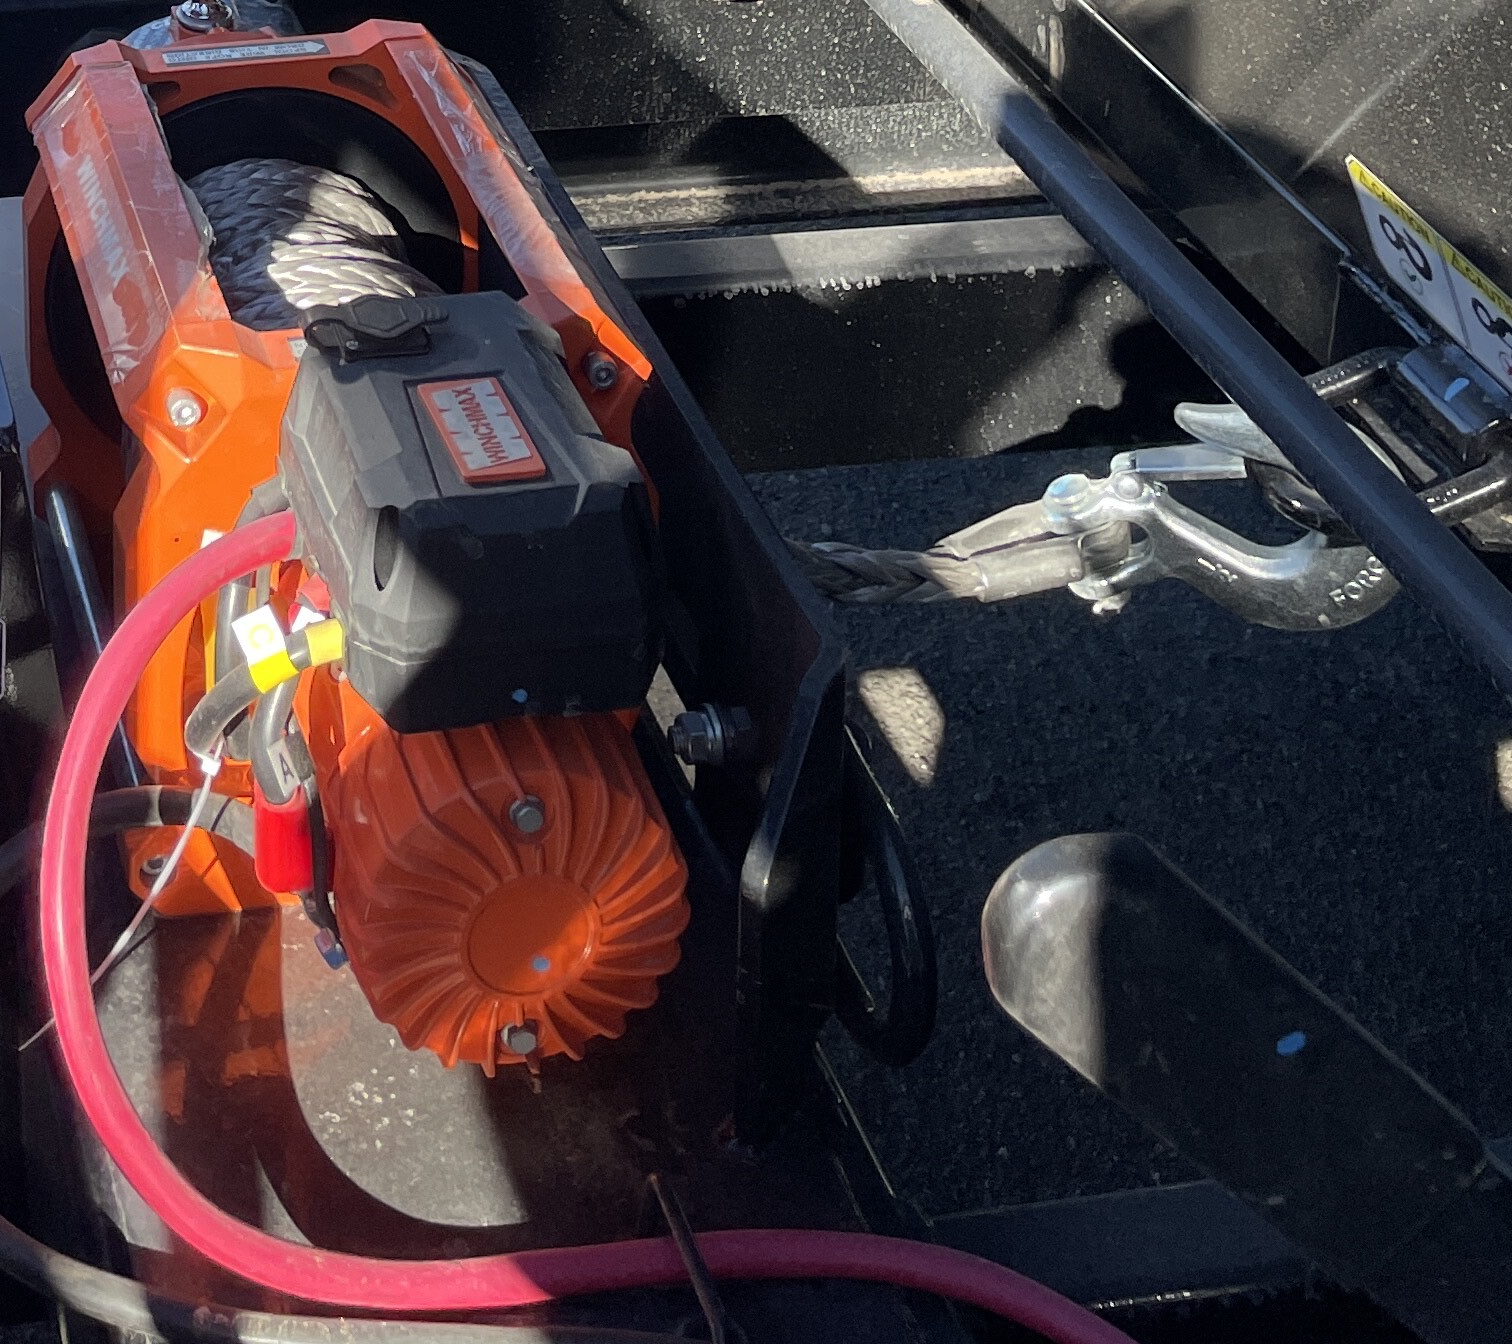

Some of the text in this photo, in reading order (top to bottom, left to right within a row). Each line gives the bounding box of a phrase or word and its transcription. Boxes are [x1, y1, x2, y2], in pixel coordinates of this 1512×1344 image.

[78, 154, 129, 288] WINCHMAX
[452, 386, 509, 464] WINCHMAX
[278, 754, 295, 785] A
